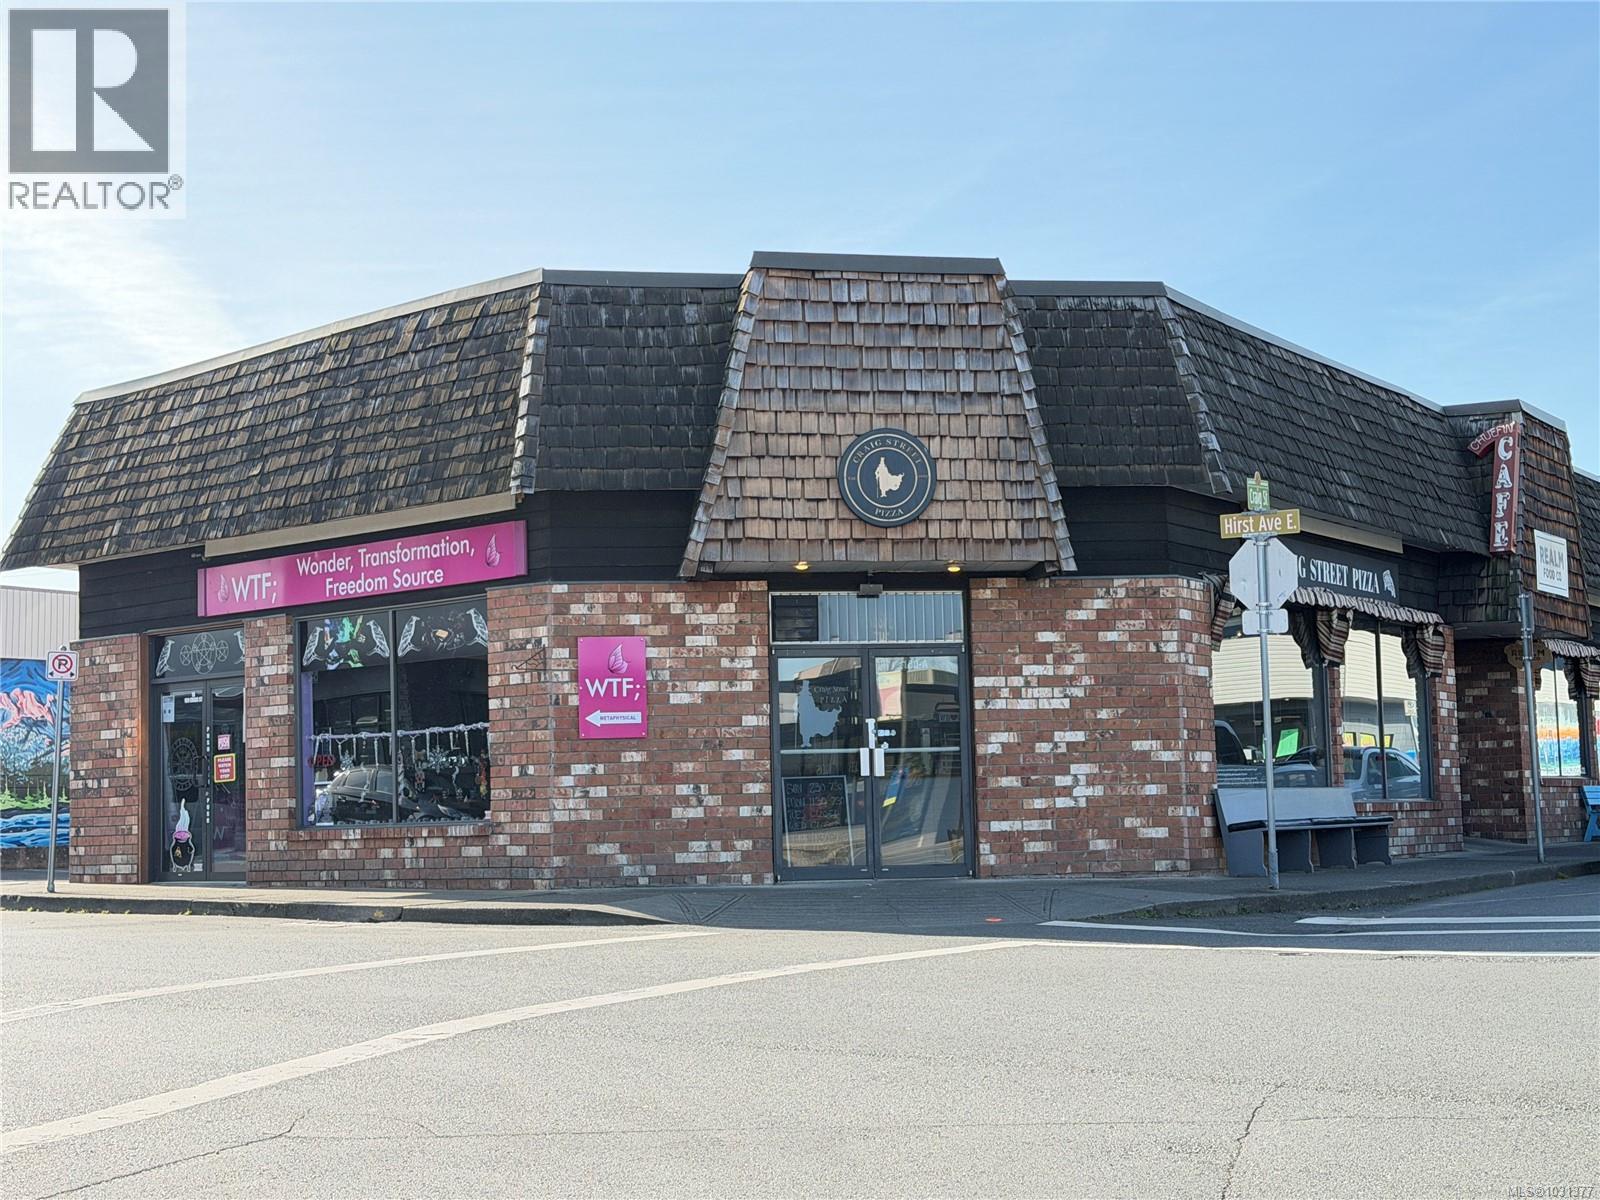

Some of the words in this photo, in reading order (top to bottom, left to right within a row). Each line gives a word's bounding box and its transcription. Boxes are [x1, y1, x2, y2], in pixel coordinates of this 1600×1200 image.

[853, 440, 882, 464] CRAIG
[886, 439, 921, 464] STREET
[1494, 436, 1514, 547] CAFE
[874, 508, 904, 517] PIZZA
[1224, 516, 1254, 534] Hirst
[1258, 515, 1282, 531] Ave
[1286, 513, 1297, 529] E.
[297, 555, 353, 577] Wonder,
[358, 537, 476, 567] Transformation,
[1539, 546, 1564, 570] REALM
[231, 572, 278, 604] WTF;
[325, 573, 388, 597] Freedom
[392, 568, 444, 589] Source
[1310, 559, 1349, 587] STREET
[1352, 567, 1380, 594] PIZZA
[585, 678, 640, 701] WTF;
